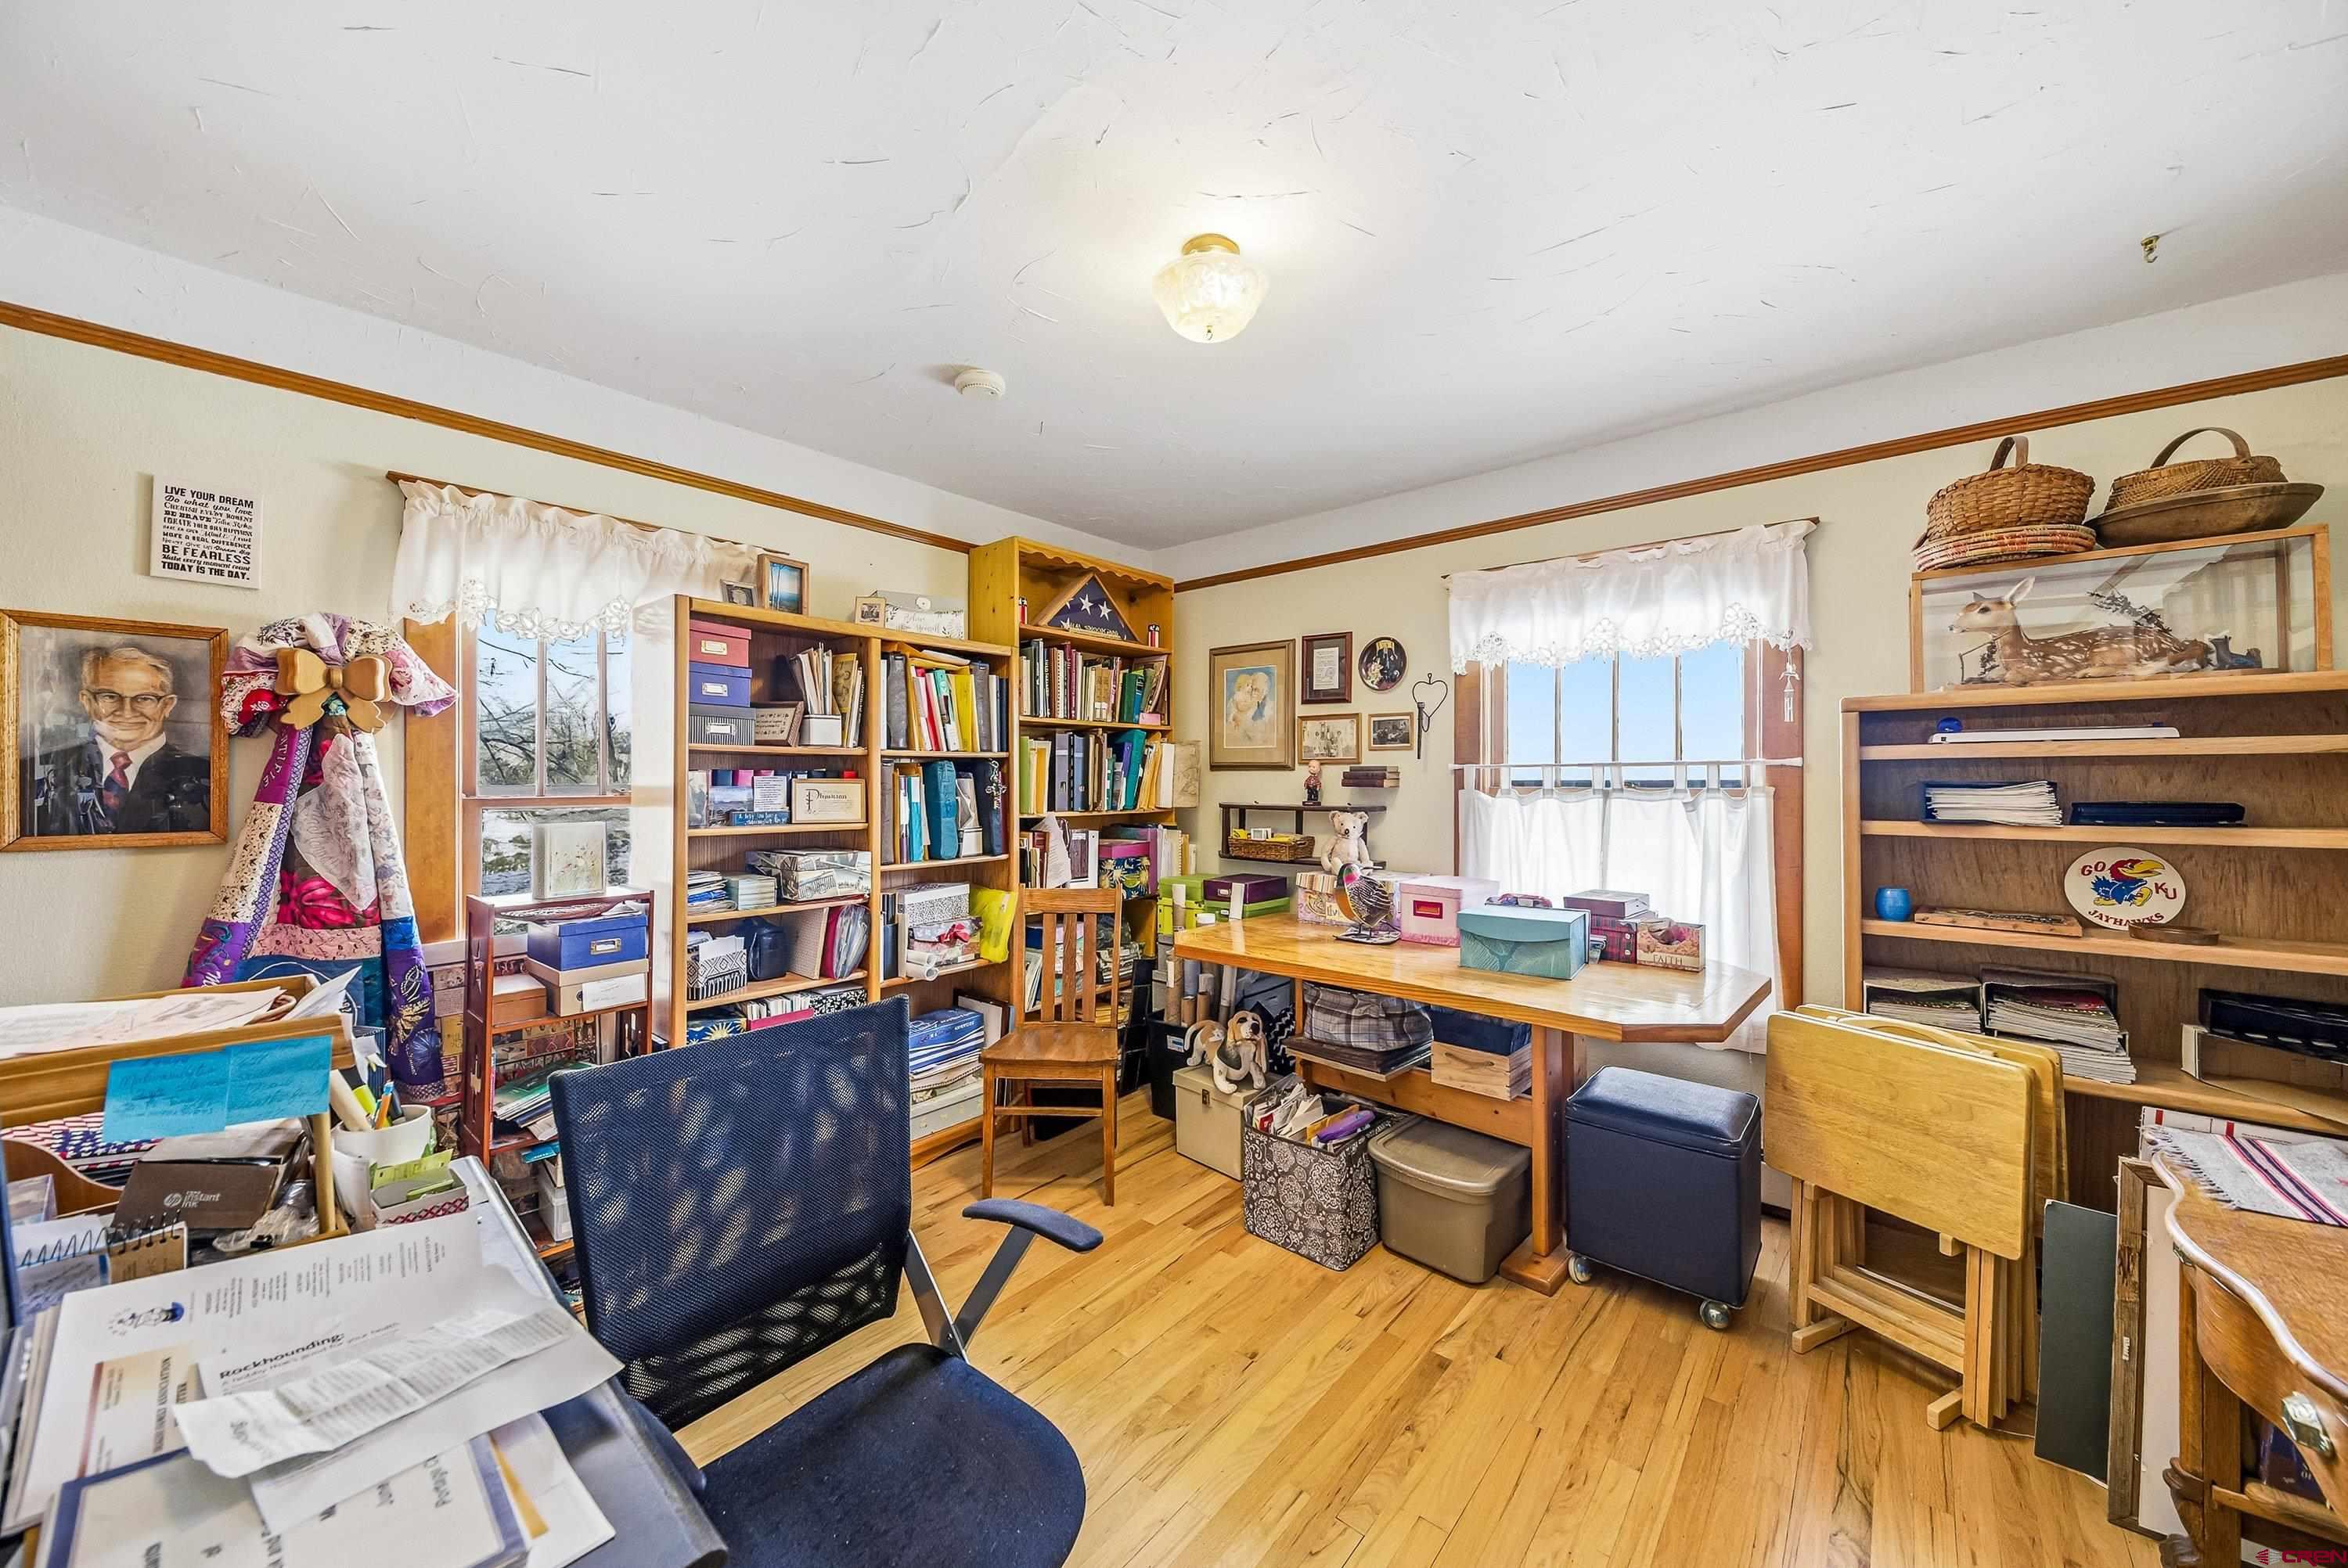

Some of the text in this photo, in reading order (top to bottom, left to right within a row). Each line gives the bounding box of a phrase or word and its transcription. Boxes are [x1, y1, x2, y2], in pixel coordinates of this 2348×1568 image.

[164, 485, 254, 509] LIVE YOUR DREAM
[164, 494, 180, 503] Do
[184, 498, 209, 508] what
[179, 512, 211, 522] BRAVE
[162, 544, 250, 565] BE FEARLESS
[161, 560, 250, 581] TODAY IS THE DAY.
[2080, 861, 2106, 876] GO
[2154, 882, 2177, 900] KU
[1653, 955, 1683, 966] FAITH
